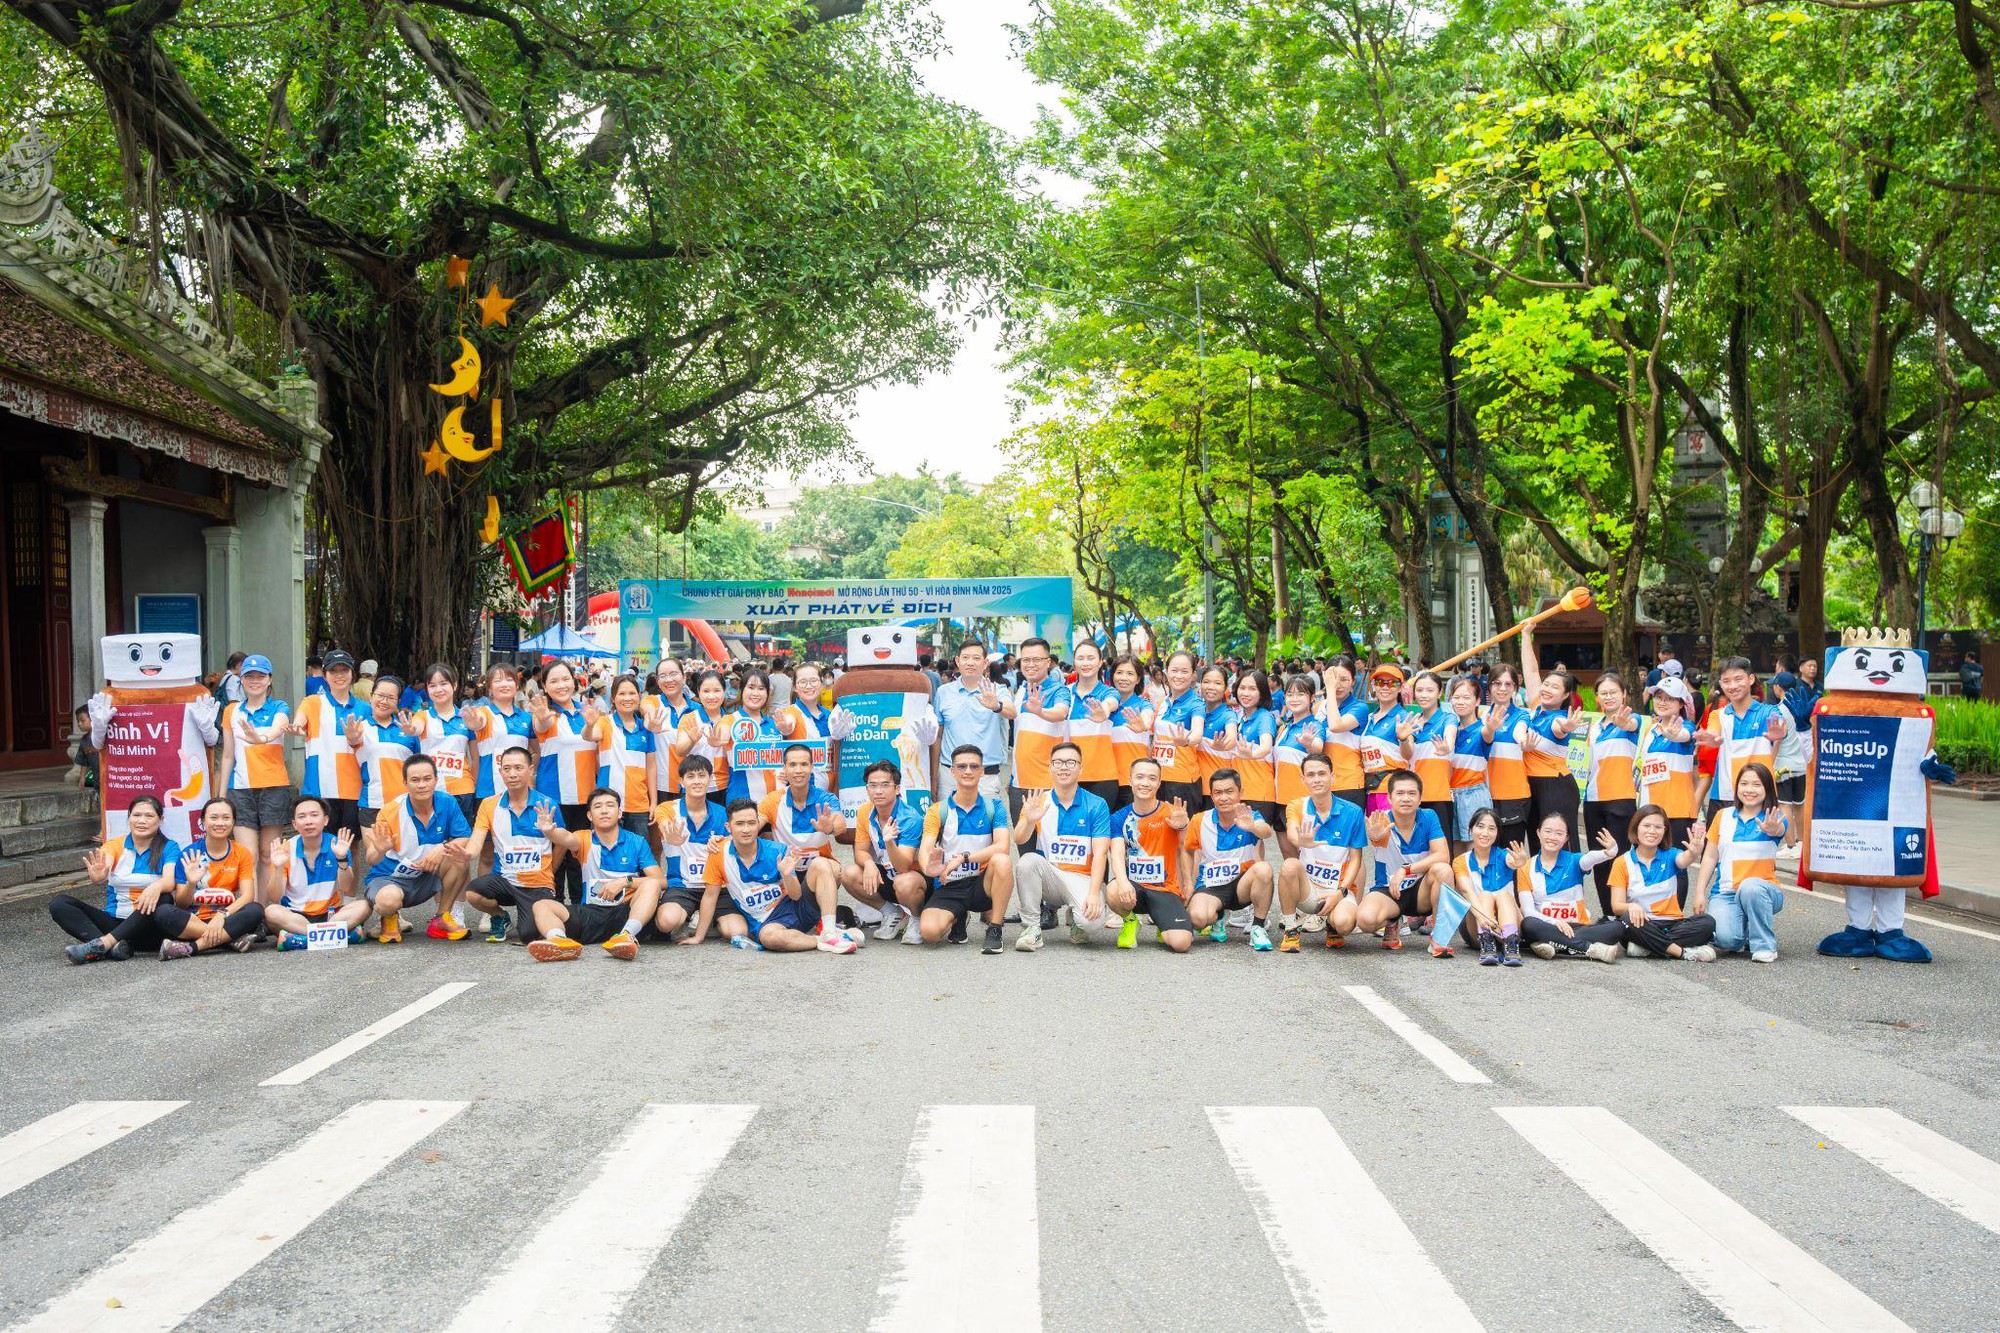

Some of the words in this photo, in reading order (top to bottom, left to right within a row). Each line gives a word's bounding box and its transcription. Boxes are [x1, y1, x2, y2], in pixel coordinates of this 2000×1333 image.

[682, 587, 709, 597] CHUNG
[711, 586, 725, 597] KẾT
[745, 587, 767, 599] CHẠY
[908, 587, 918, 596] 50
[926, 585, 933, 595] VÌ
[953, 585, 970, 595] BÌNH
[973, 585, 990, 595] NĂM
[992, 586, 1012, 595] 2025
[746, 599, 800, 615] XUẤT
[901, 599, 952, 614] ĐÍCH
[107, 722, 141, 740] Bình
[146, 721, 170, 743] Vị
[863, 729, 889, 741] Đan
[108, 744, 124, 755] Thái
[127, 745, 156, 755] Minh
[737, 747, 758, 768] DƯỢC
[760, 742, 783, 765] PHẨM
[1362, 748, 1382, 762] 788
[1820, 739, 1889, 759] KingsUp
[842, 809, 858, 819] 180
[1051, 842, 1086, 856] 9778
[505, 852, 540, 864] 9774
[398, 865, 421, 876] 977
[689, 864, 705, 875] 97
[1130, 863, 1161, 874] 9791
[1207, 864, 1239, 879] 9792
[1306, 864, 1339, 881] 9782
[196, 895, 234, 905] 9780
[746, 887, 782, 907] 9786
[1542, 907, 1577, 919] 9784
[309, 928, 346, 942] 9770
